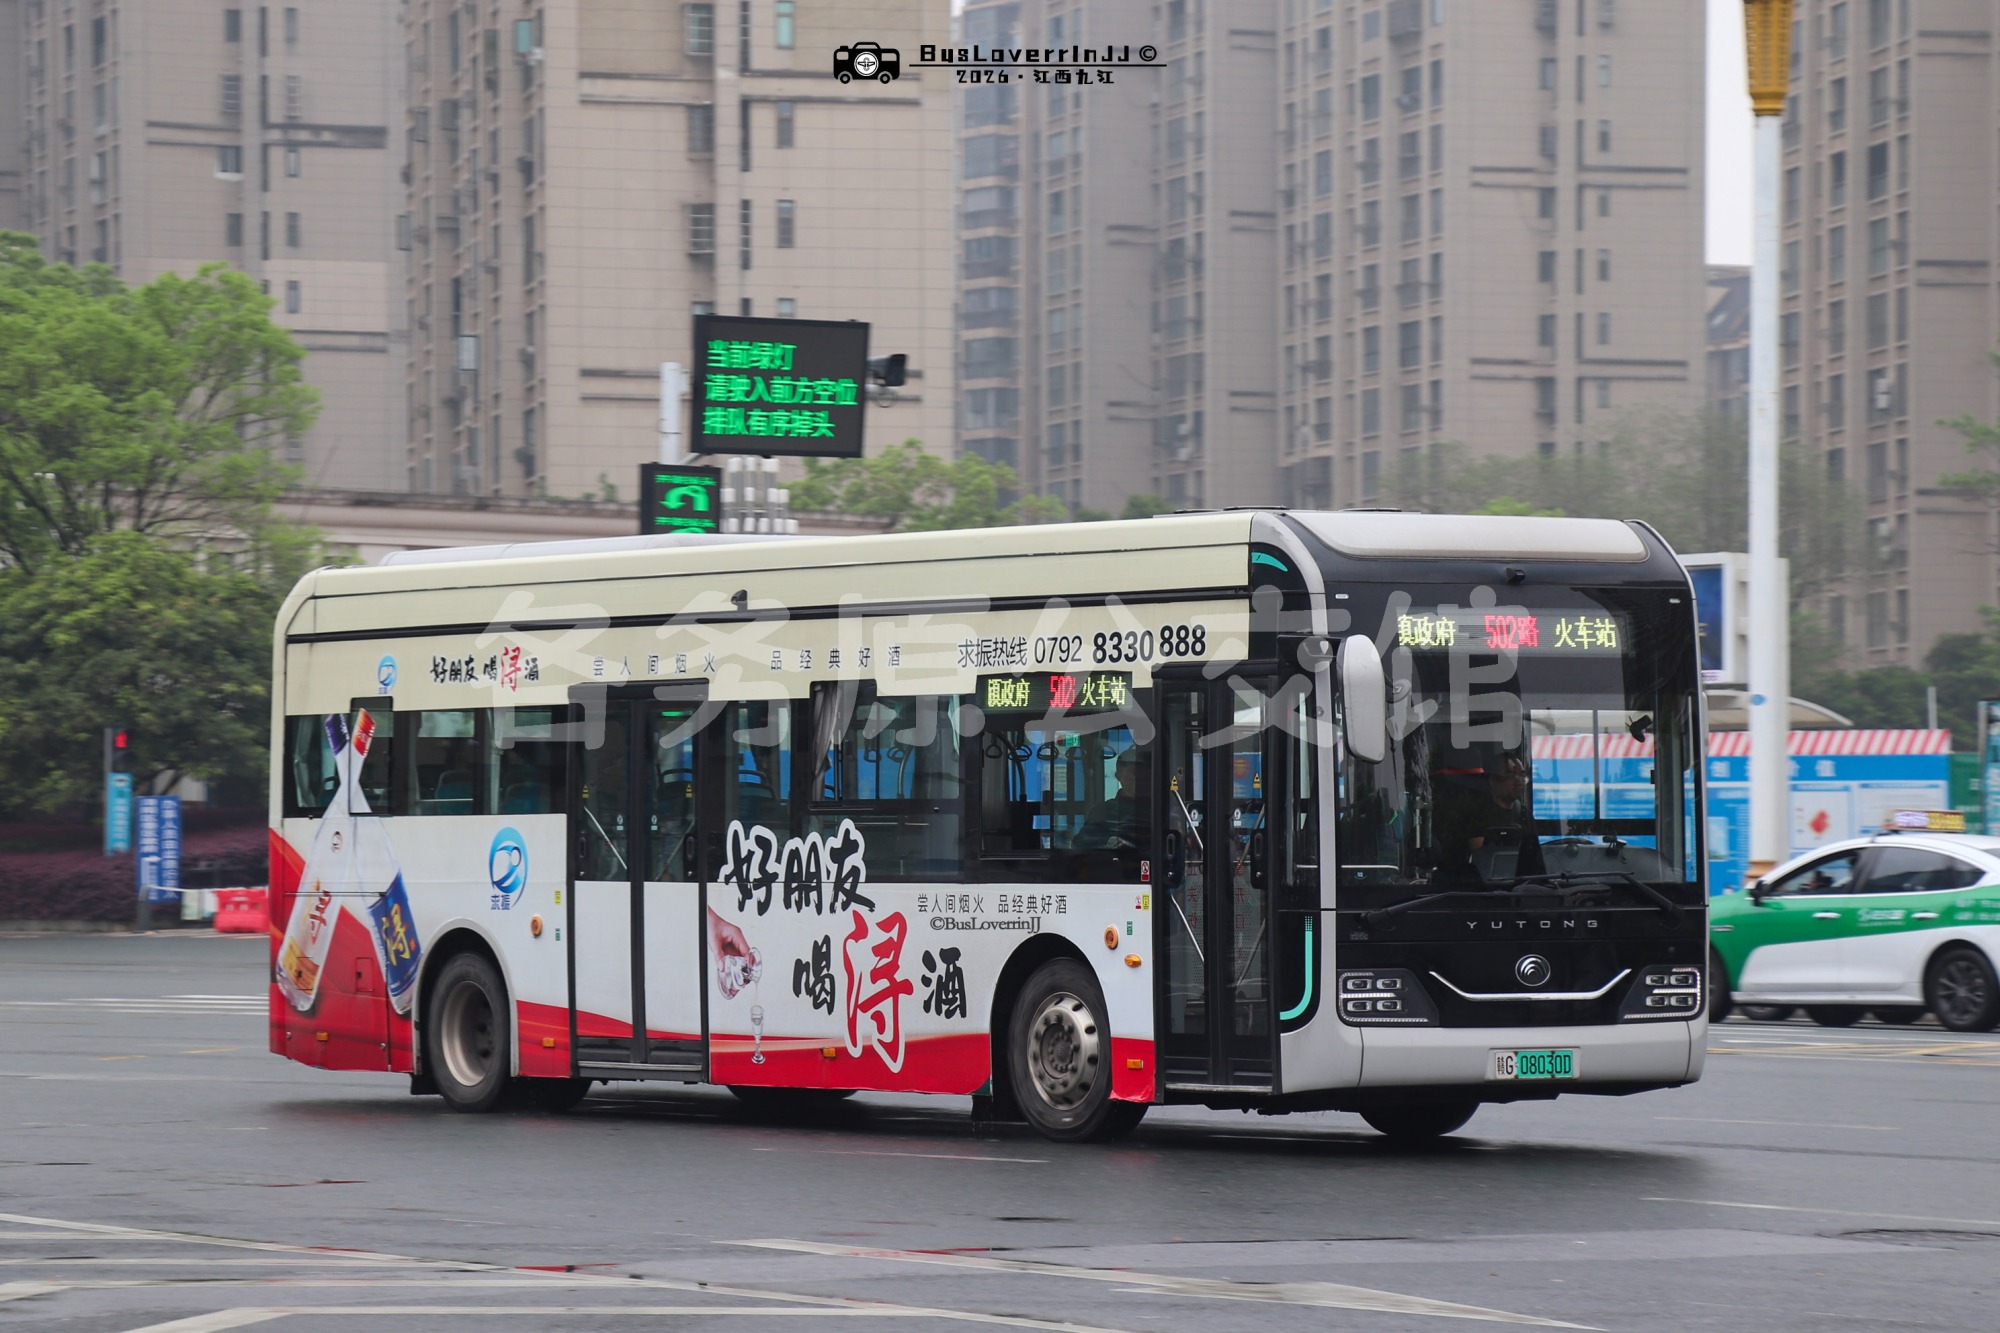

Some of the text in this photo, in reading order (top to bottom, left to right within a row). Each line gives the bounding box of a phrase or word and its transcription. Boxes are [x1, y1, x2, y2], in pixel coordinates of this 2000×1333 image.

[706, 339, 797, 370] 当前绿灯
[1034, 635, 1083, 664] 0792
[1092, 630, 1154, 664] 8330
[1159, 625, 1206, 657] 888
[1554, 616, 1617, 649] 火车站
[593, 645, 901, 677] 尝人间烟火 品经典好酒
[1081, 675, 1126, 707] 火车站
[721, 820, 876, 916] 好朋友
[917, 893, 1067, 915] 尝人间烟火 品经典好酒
[1466, 919, 1598, 929] YUTONG
